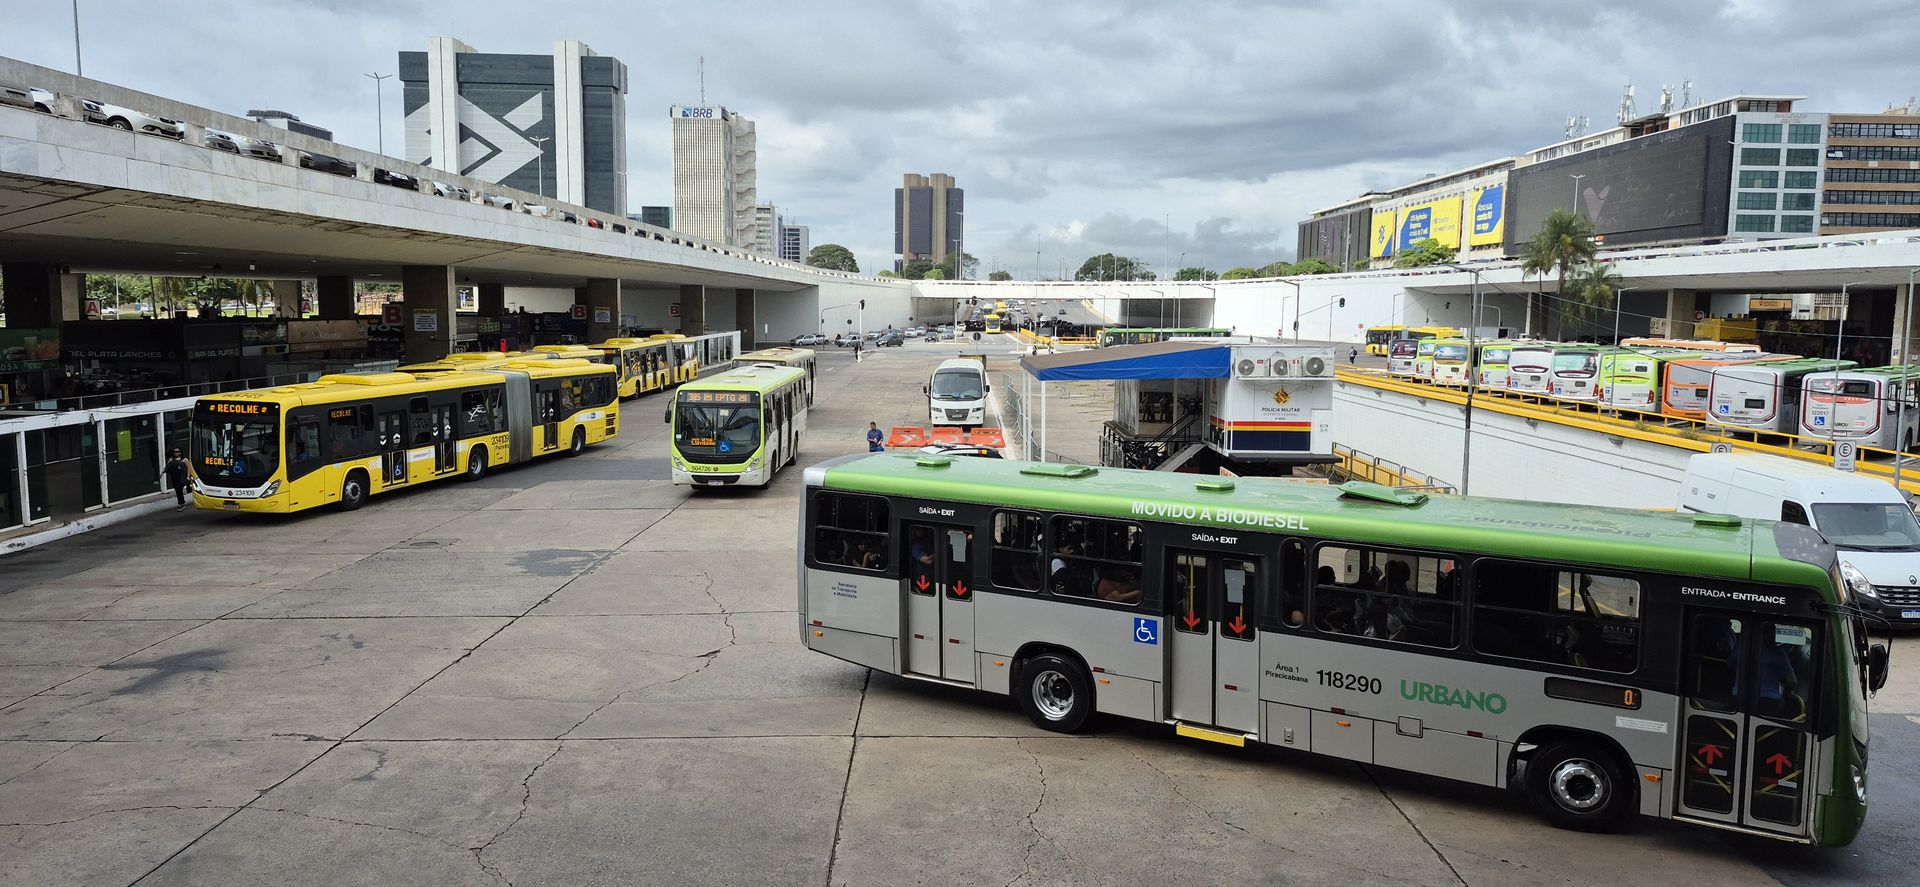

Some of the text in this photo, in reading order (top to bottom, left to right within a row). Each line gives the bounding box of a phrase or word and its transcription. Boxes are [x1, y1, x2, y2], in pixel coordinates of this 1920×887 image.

[692, 107, 713, 118] BRB
[86, 301, 99, 313] A
[303, 302, 312, 311] A
[574, 306, 585, 317] B
[670, 305, 679, 314] B
[88, 350, 117, 358] PLATA
[715, 393, 736, 401] EPTG
[217, 404, 259, 414] RECOLHE
[1843, 446, 1849, 454] E
[918, 506, 955, 517] SAÍDA EXIT
[1131, 501, 1309, 531] MOVIDO A BIODIESEL
[1191, 532, 1238, 545] SAÍDA EXIT
[1681, 586, 1786, 604] ENTRADA ENTRANCE
[1275, 661, 1299, 674] Área 1
[1265, 670, 1309, 683] Piracicabana
[1316, 669, 1383, 695] 118290
[1399, 679, 1508, 714] URBANO
